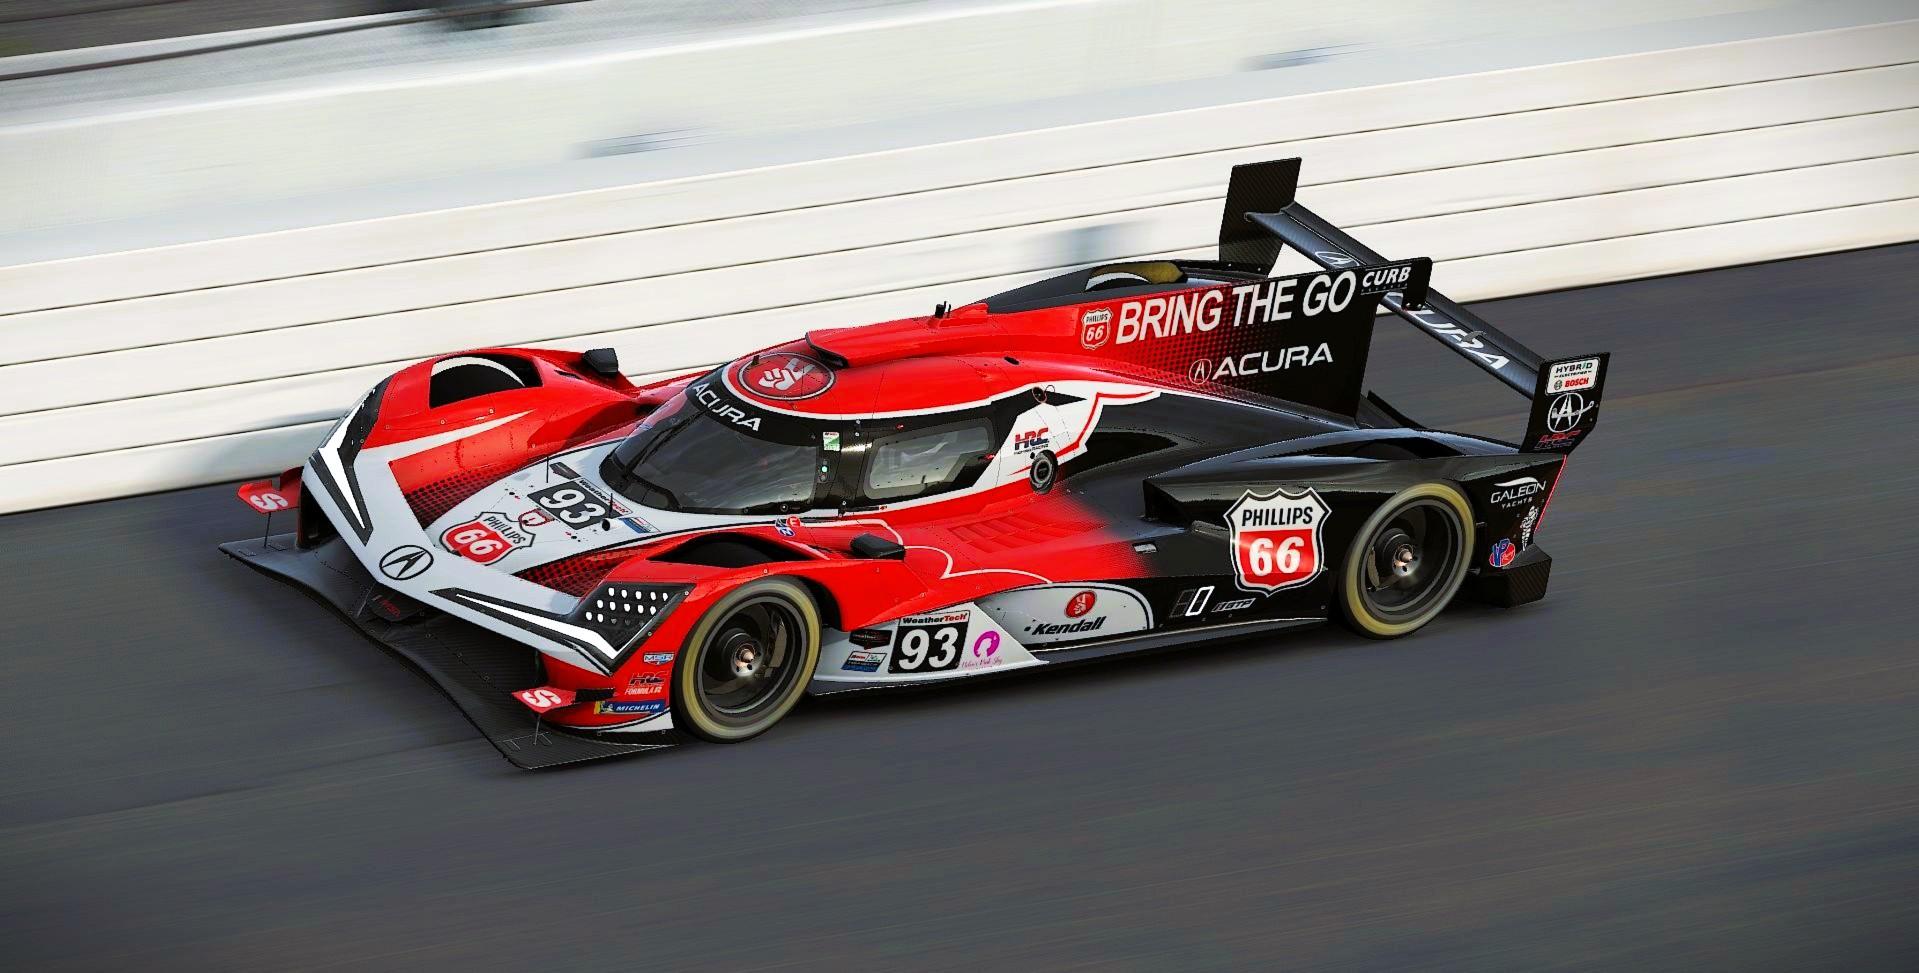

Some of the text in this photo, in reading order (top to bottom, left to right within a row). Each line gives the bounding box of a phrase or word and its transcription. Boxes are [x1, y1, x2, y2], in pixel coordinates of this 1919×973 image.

[1361, 266, 1412, 288] CURB
[1086, 313, 1109, 323] PHILLIPS
[1116, 271, 1357, 345] BRING THE GO
[1086, 325, 1105, 342] 66
[1212, 342, 1334, 380] ACURA
[1556, 361, 1593, 374] HYBRID
[1564, 377, 1589, 388] BOSCH
[693, 383, 762, 432] ACURA
[1014, 427, 1050, 451] HRC
[1491, 480, 1547, 504] GALEON
[1501, 496, 1533, 509] YACHTS
[539, 489, 606, 524] 93
[1241, 506, 1314, 527] PHILLIPS
[454, 528, 503, 555] 66
[483, 515, 527, 545] PHILLIPS
[1249, 536, 1305, 577] 66
[902, 613, 968, 625] WeatherTech
[1031, 616, 1107, 636] Kendall
[899, 627, 959, 670] 93
